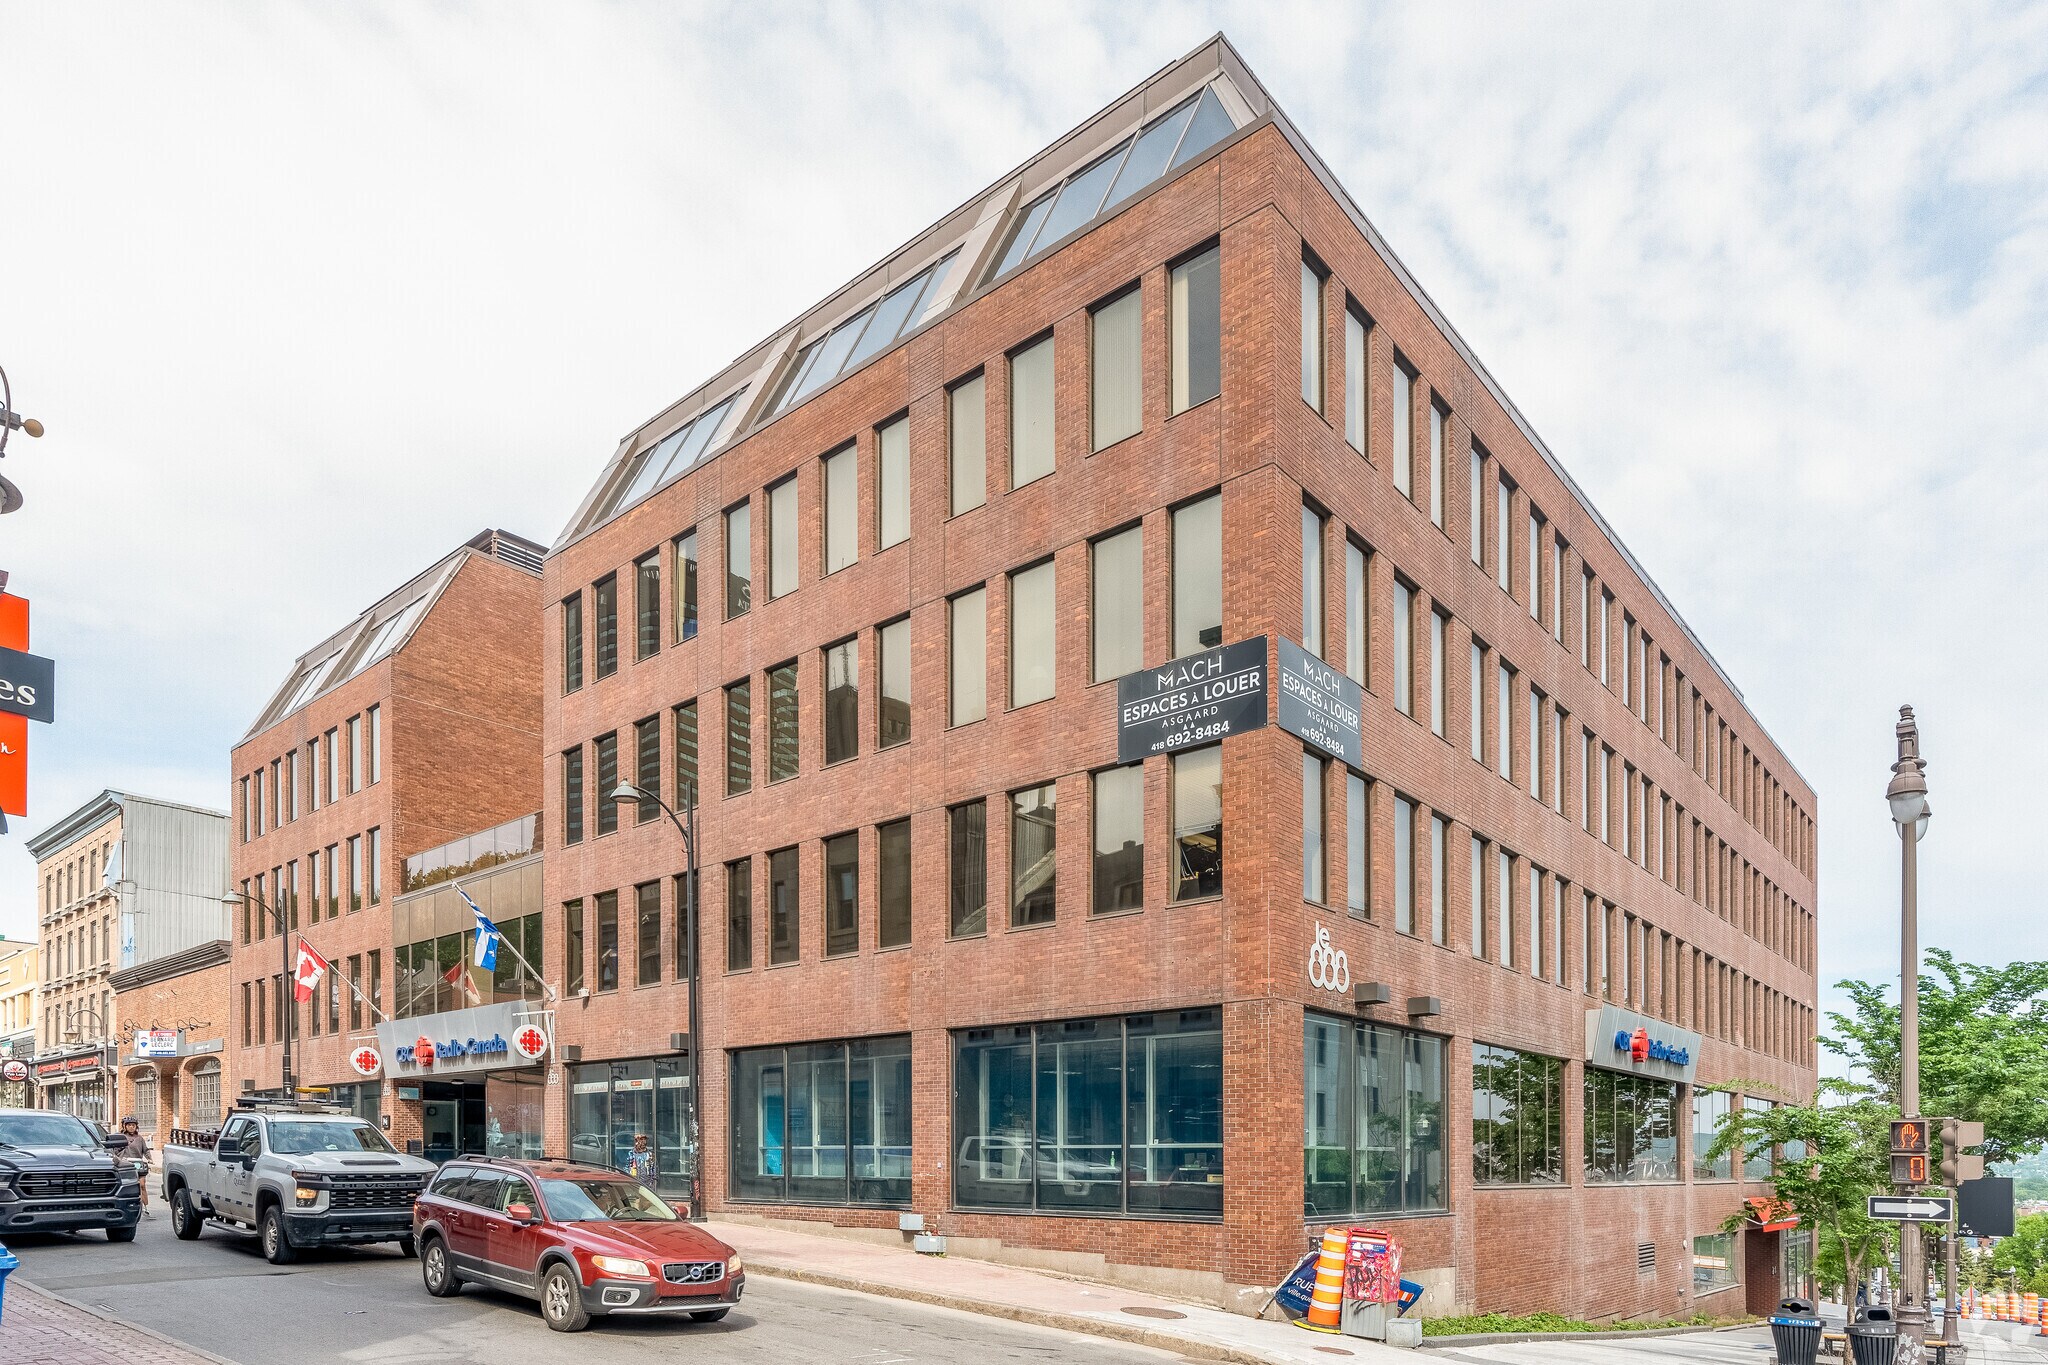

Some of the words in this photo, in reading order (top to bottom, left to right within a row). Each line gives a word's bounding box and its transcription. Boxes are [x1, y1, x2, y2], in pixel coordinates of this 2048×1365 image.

[1157, 655, 1222, 691] MACH
[1303, 658, 1340, 697] MACH
[1123, 693, 1188, 723] ESPACES
[1191, 692, 1199, 705] À
[1204, 671, 1260, 701] LOUER
[1282, 674, 1322, 706] ESPACES
[1330, 698, 1358, 730] LOUER
[1162, 706, 1218, 729] ASGAARD
[1307, 710, 1339, 733] ASGAARD
[1151, 741, 1165, 751] 418
[1166, 720, 1230, 747] 692-8484
[1301, 726, 1310, 736] 418
[1310, 729, 1345, 756] 692-8484
[1315, 920, 1330, 949] le
[1308, 942, 1349, 994] 888
[395, 1046, 416, 1063] CBC
[1292, 1276, 1315, 1292] RUE
